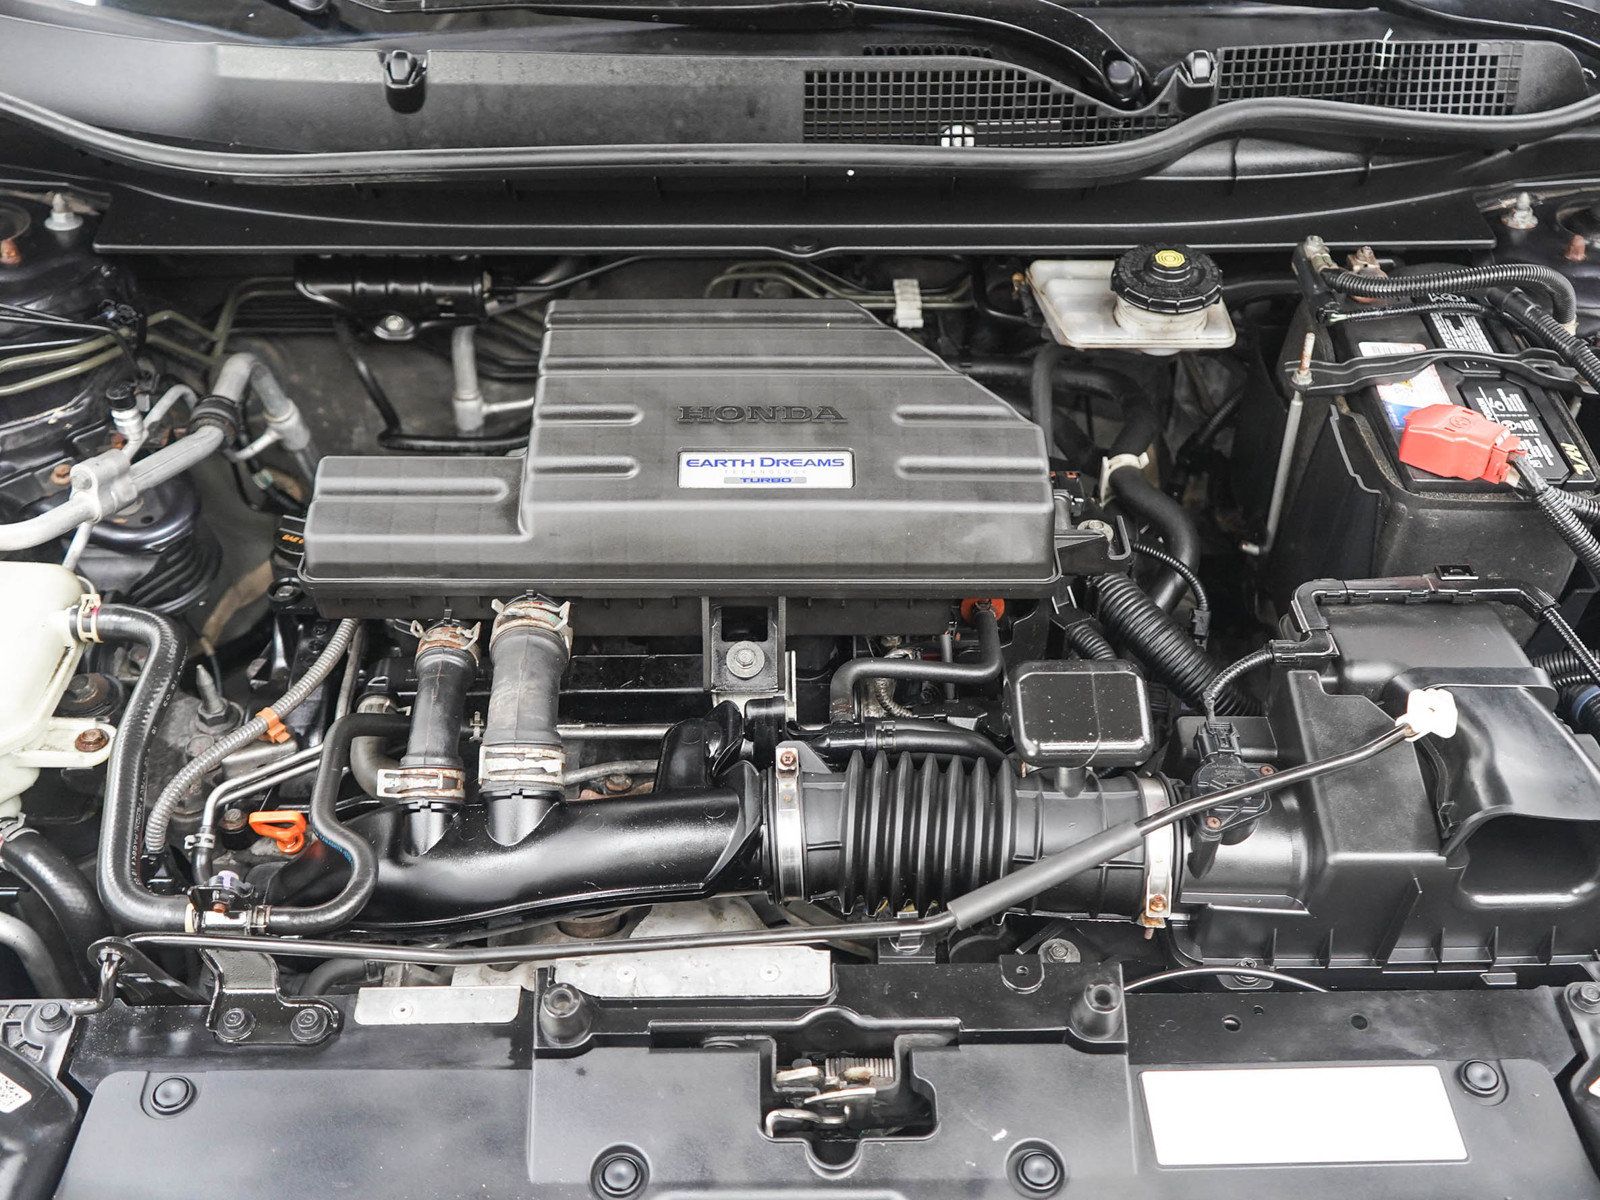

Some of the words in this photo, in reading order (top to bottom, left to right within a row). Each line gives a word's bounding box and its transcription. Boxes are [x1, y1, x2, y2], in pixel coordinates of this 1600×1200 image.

[678, 406, 847, 423] HONDA
[686, 459, 754, 467] EARTH
[760, 457, 844, 467] DREAMS
